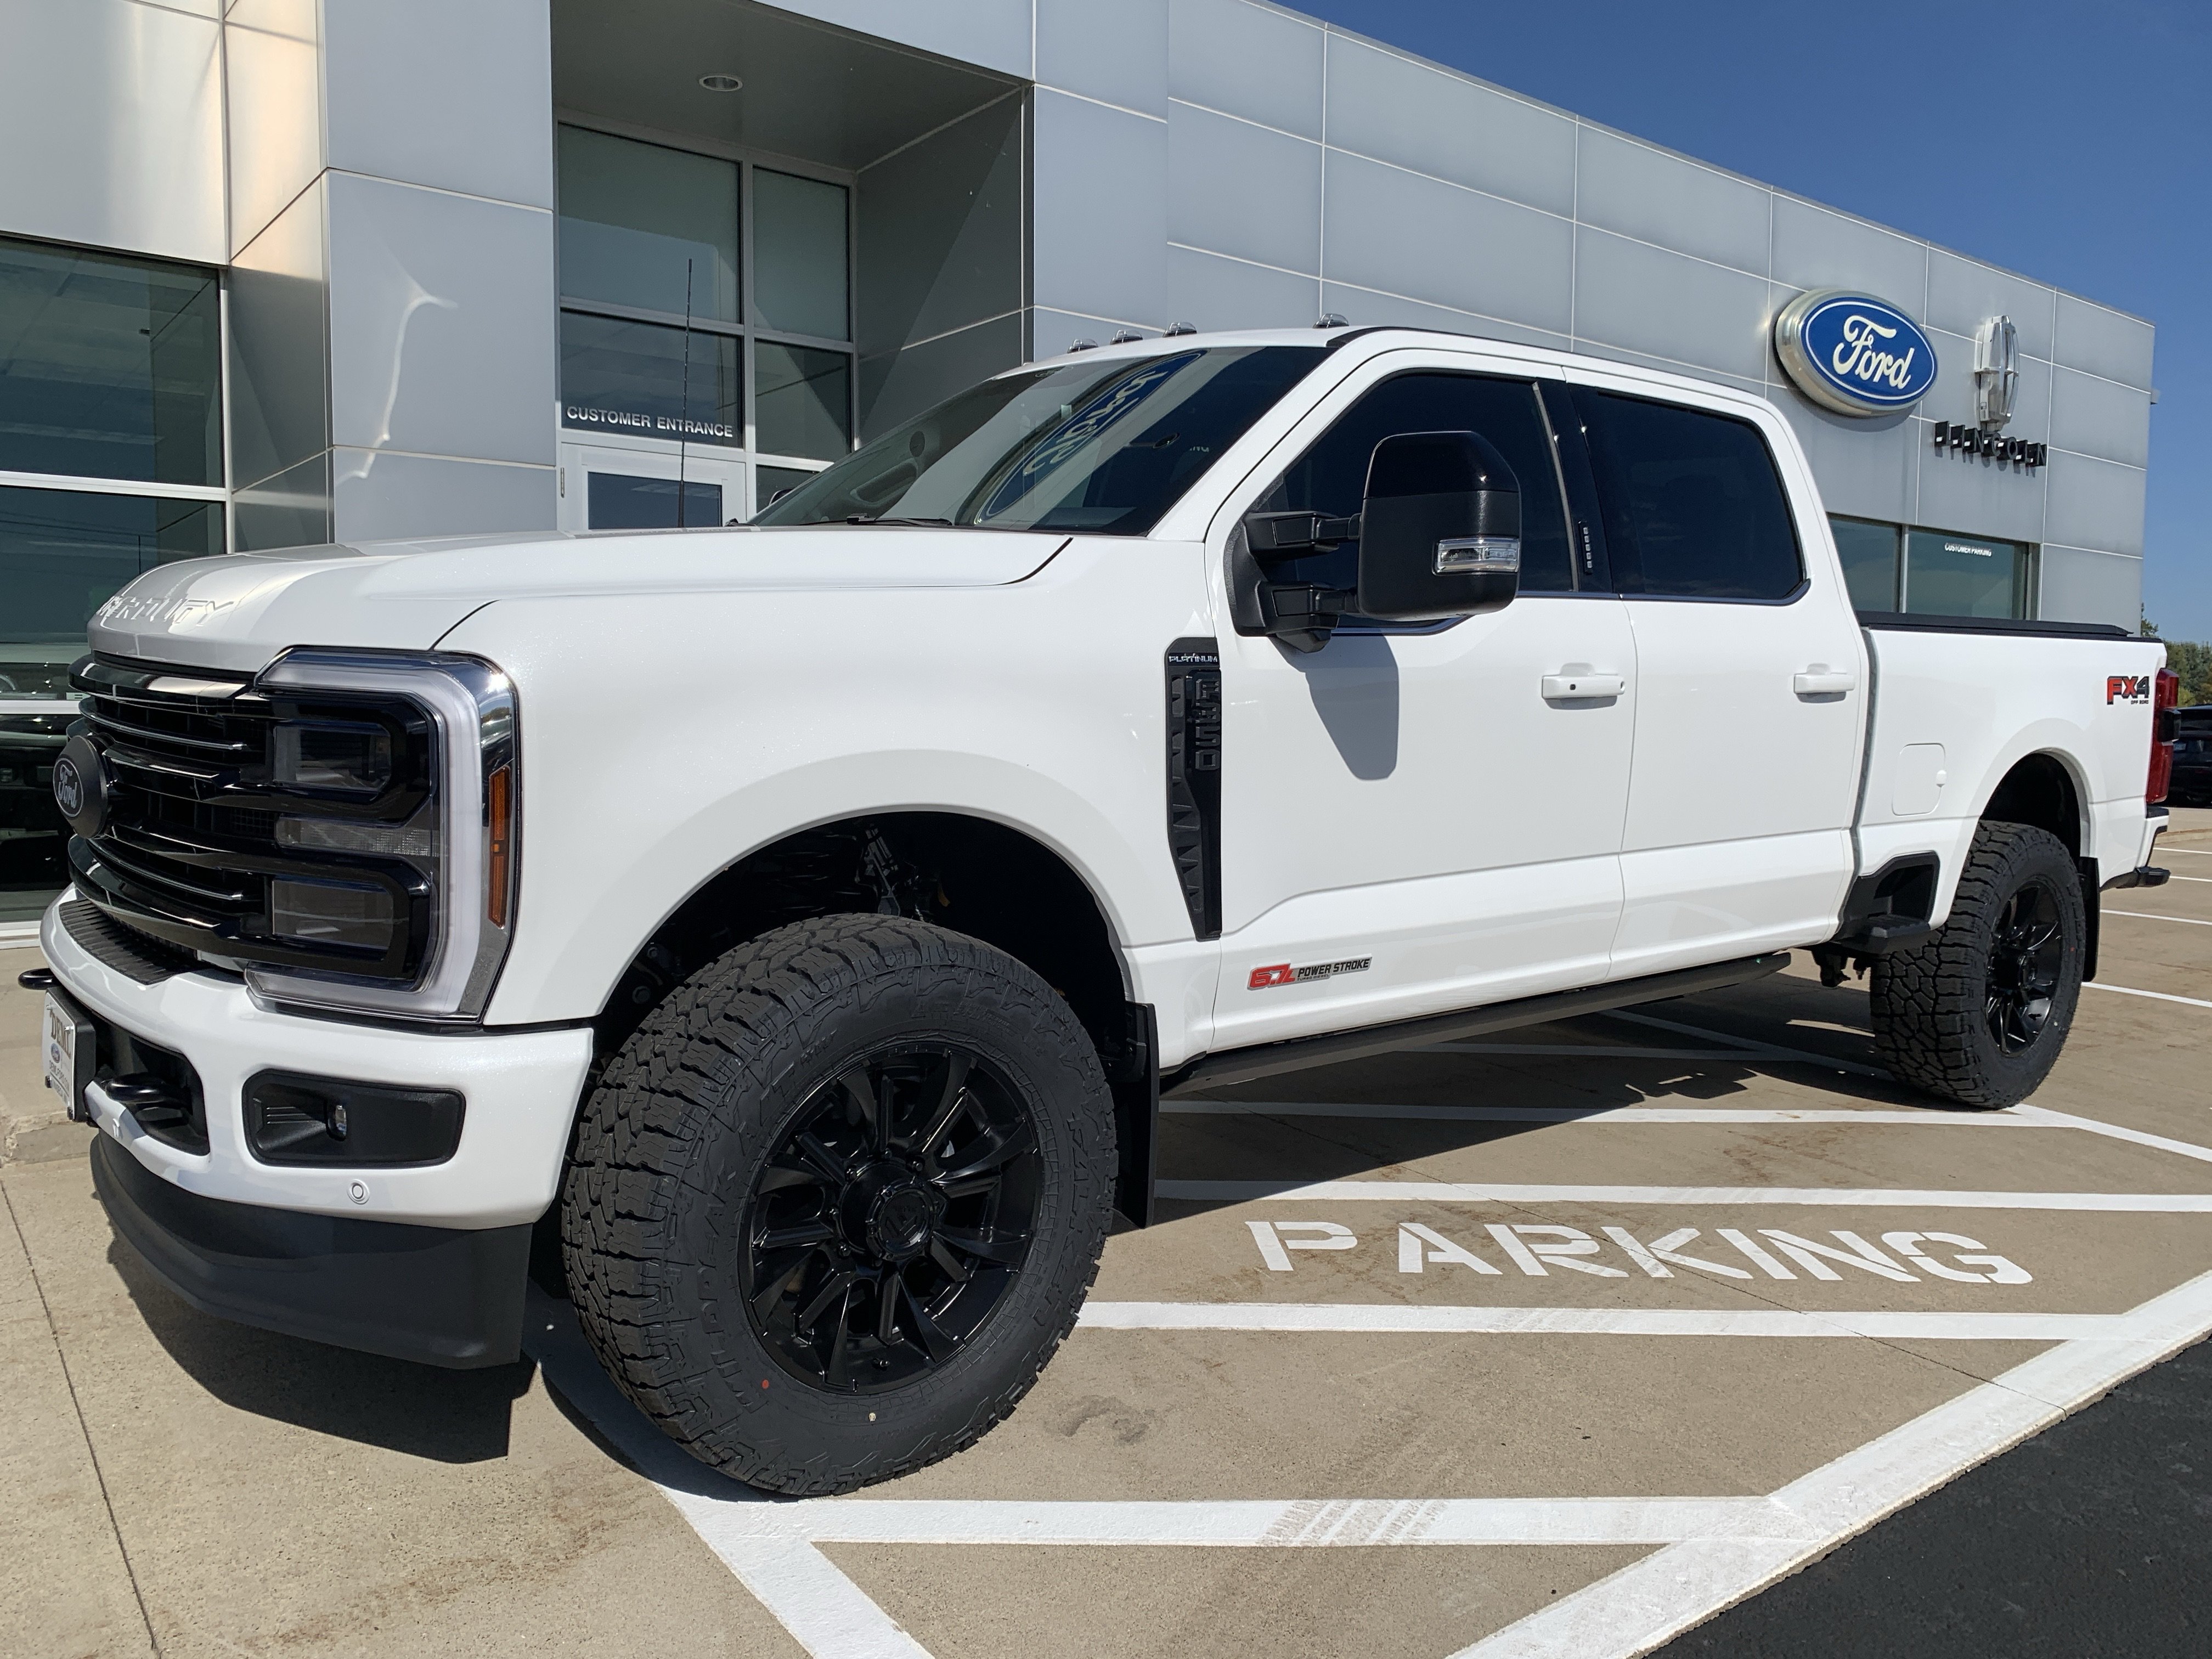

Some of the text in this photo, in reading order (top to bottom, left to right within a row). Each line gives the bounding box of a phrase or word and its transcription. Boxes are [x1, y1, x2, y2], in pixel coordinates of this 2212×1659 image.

[1832, 315, 1915, 390] Ford
[566, 406, 733, 438] CUSTOMER ENTRANCE
[1944, 542, 1992, 557] CUSTOMER PARKING
[2107, 675, 2149, 706] FX4
[58, 764, 77, 809] Ford
[1297, 963, 1331, 978] POWER
[1333, 958, 1370, 973] STROKE
[1244, 1220, 2034, 1285] PARKING
